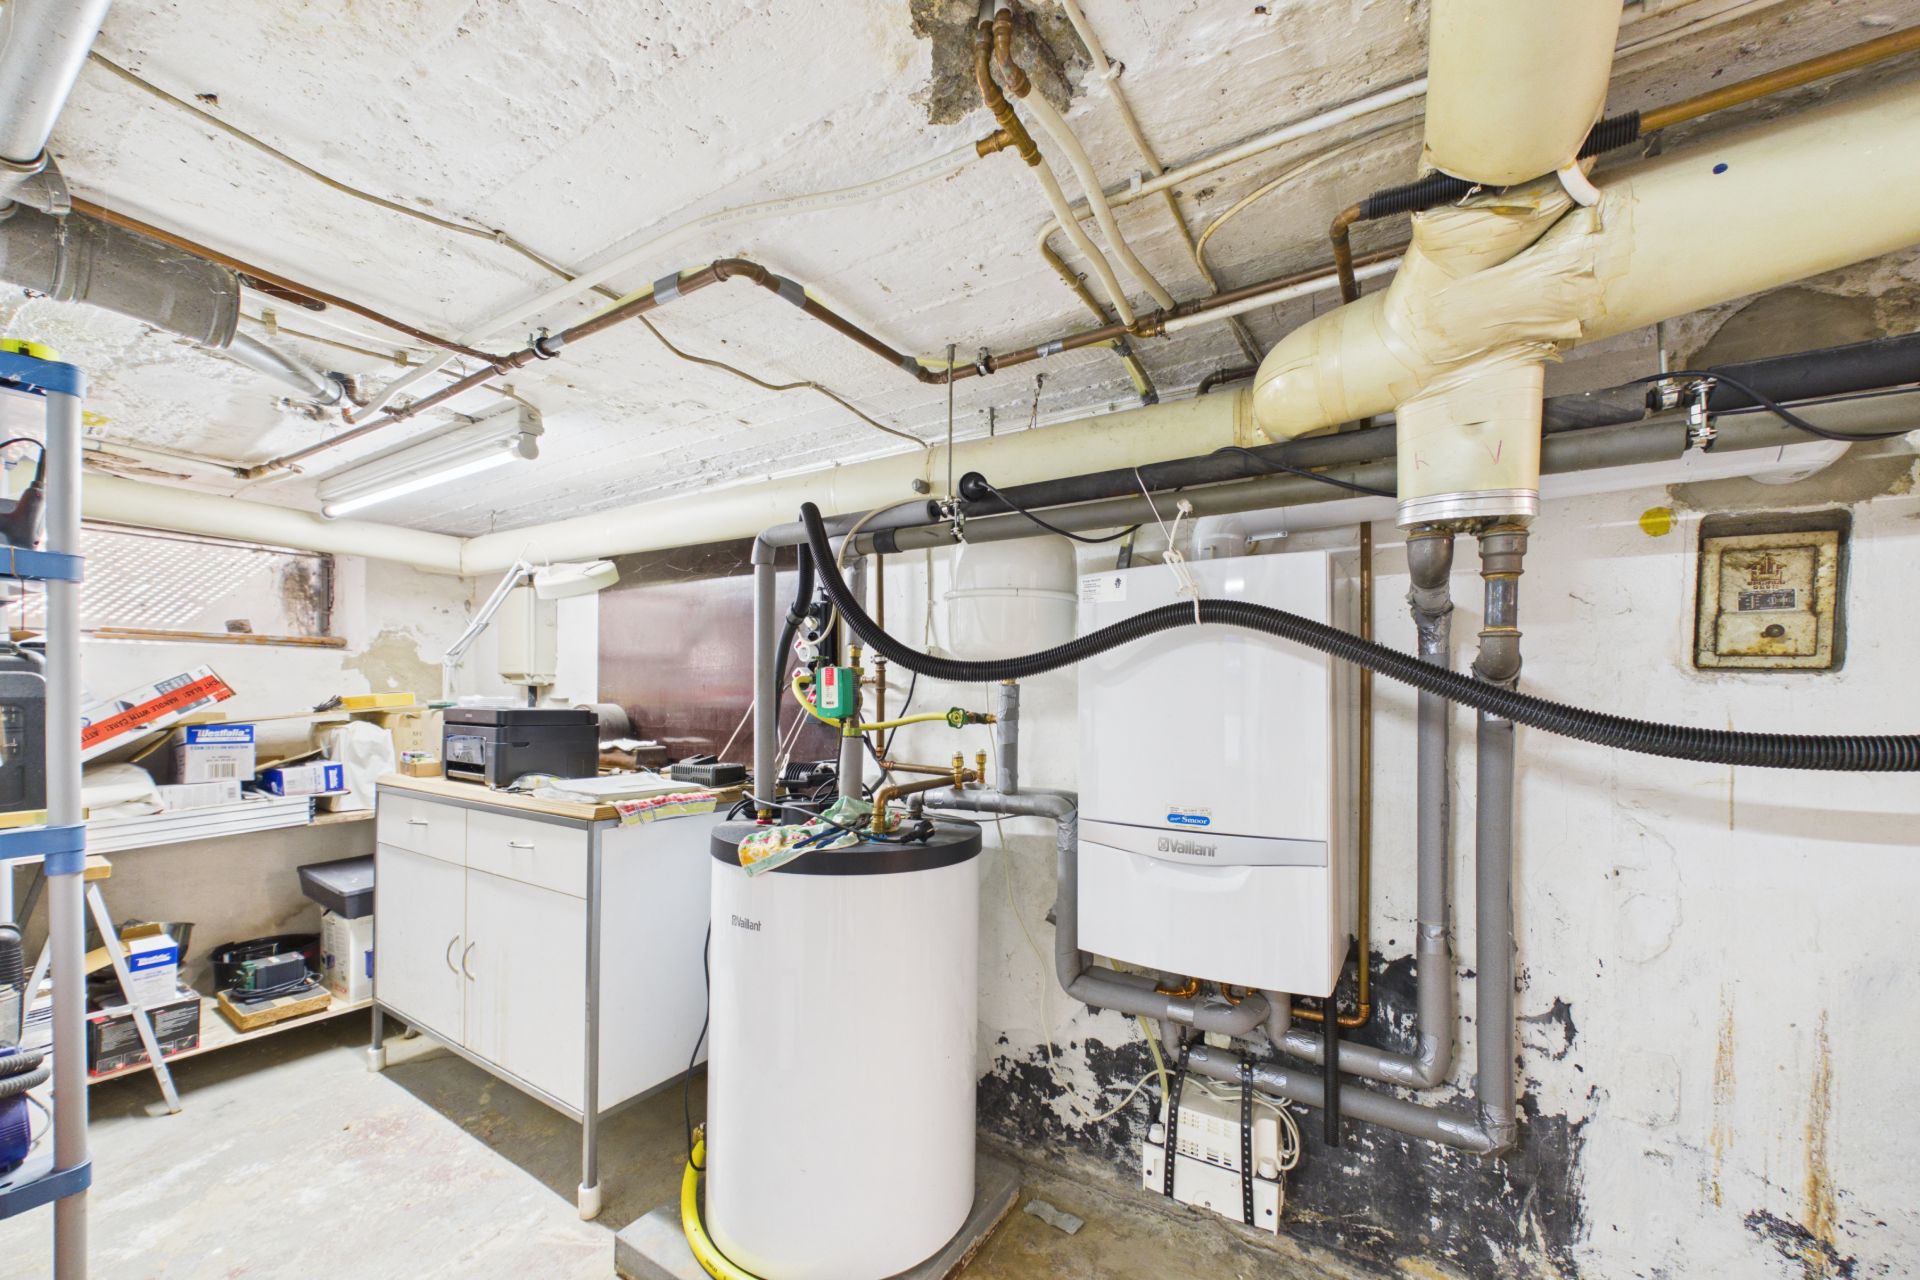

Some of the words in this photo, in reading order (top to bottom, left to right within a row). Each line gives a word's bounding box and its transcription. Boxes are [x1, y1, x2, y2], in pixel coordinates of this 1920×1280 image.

[150, 697, 178, 713] HANDLE
[129, 707, 149, 721] WITH
[104, 717, 129, 732] CARE!
[1170, 838, 1217, 857] Vaillant
[736, 916, 762, 931] Vaillant
